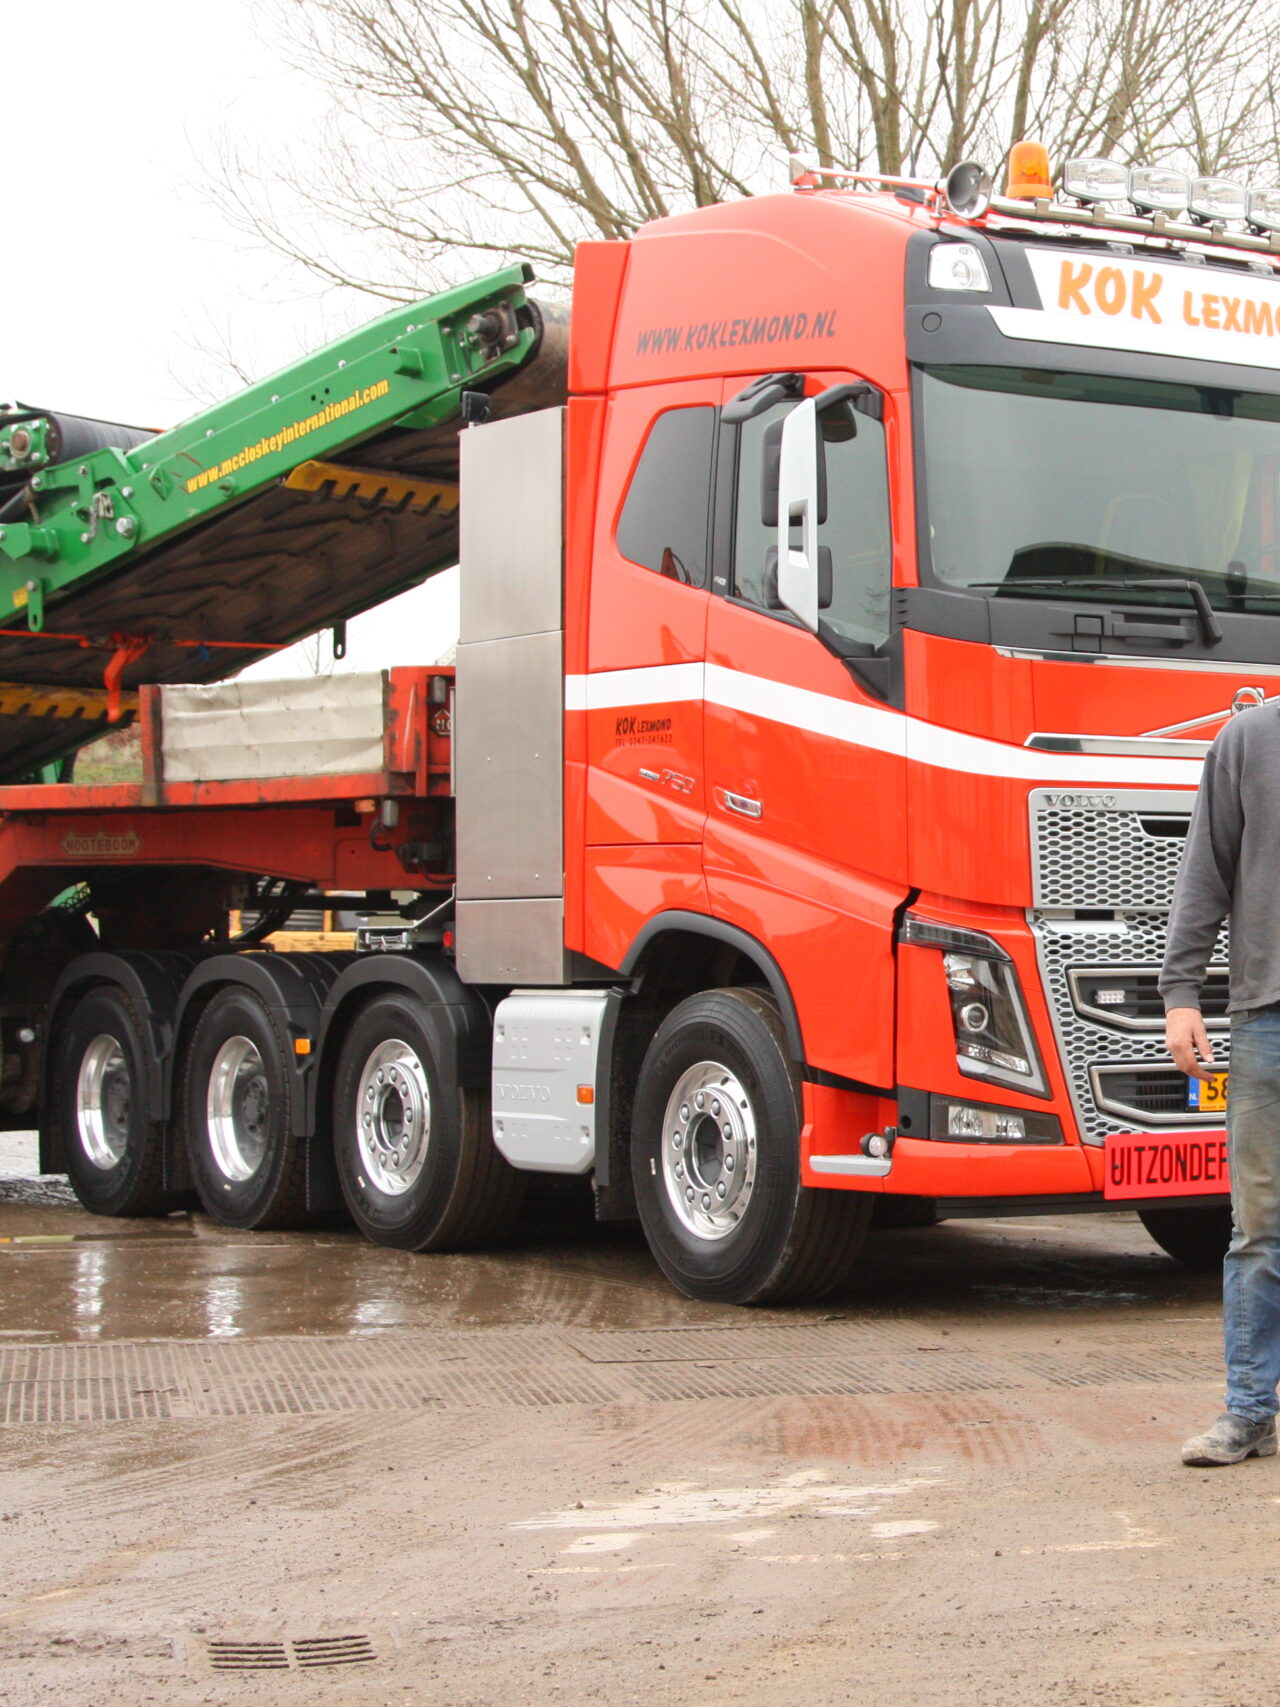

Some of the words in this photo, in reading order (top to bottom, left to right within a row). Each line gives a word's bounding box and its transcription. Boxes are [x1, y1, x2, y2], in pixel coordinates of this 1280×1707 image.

[1058, 260, 1163, 324] KOK
[636, 310, 836, 356] WWW.KOKLEXMOND.NL
[186, 378, 389, 494] www.mccloskeyinternational.com
[615, 716, 637, 736] KOK
[637, 718, 673, 733] LEXMOND
[1041, 794, 1117, 808] VOLVO
[66, 838, 136, 852] NOOTEBOOM
[496, 1083, 551, 1101] VOLVO
